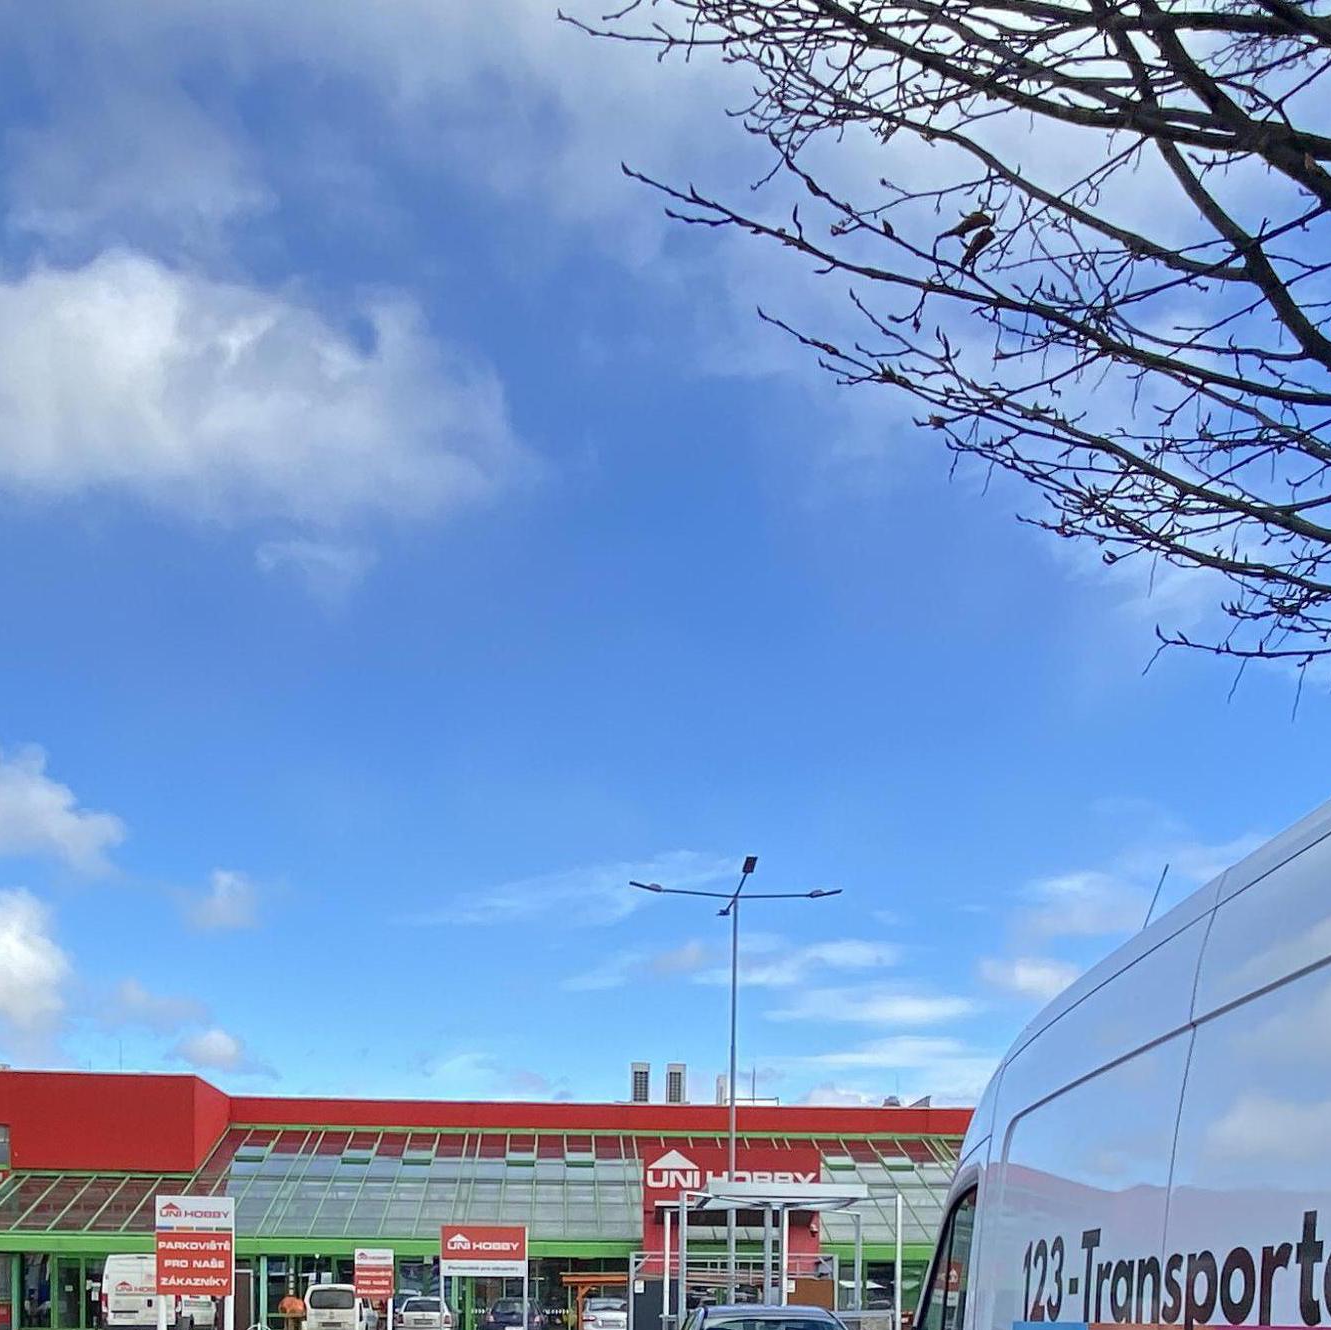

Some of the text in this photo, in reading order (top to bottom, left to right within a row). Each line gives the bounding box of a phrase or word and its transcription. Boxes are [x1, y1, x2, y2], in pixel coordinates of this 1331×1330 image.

[646, 1170, 700, 1189] UNI
[159, 1209, 230, 1219] UNI HOBBY
[158, 1239, 231, 1251] PARKOVIŠTĚ
[447, 1241, 520, 1251] UNI HOBBY
[164, 1257, 225, 1269] PRO NAŠE
[160, 1274, 229, 1287] ZÁKAZNÍKY
